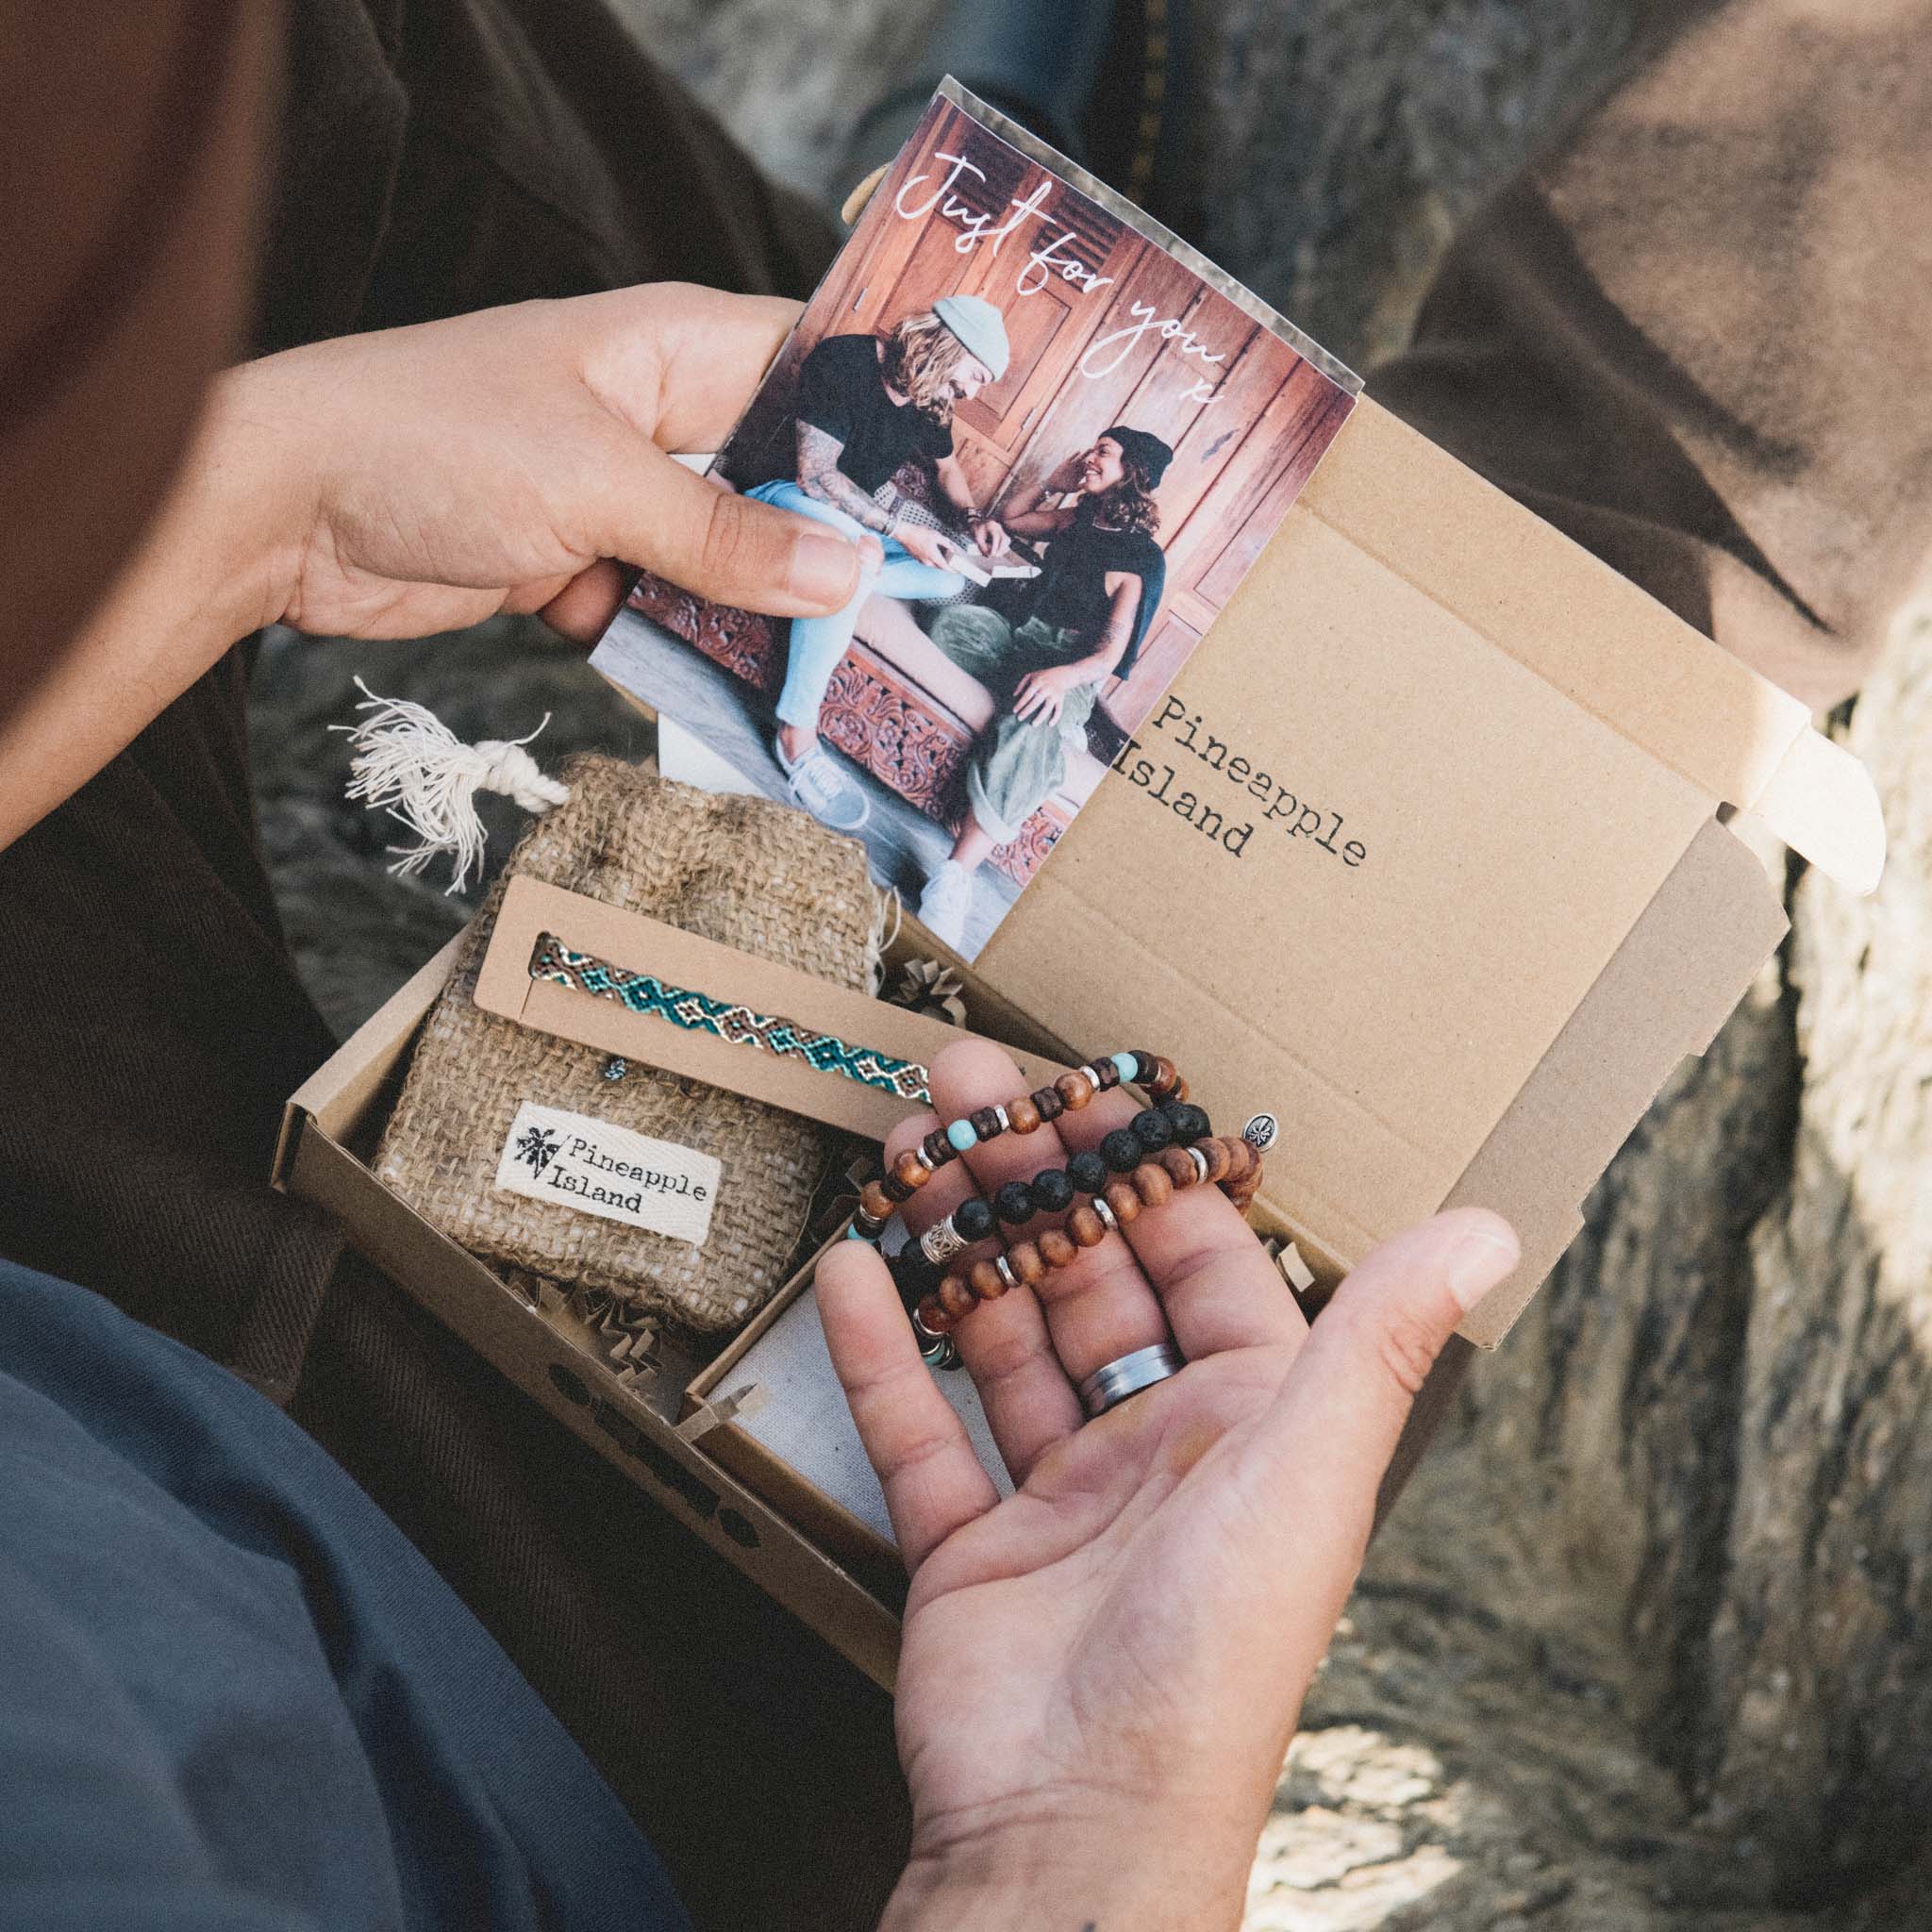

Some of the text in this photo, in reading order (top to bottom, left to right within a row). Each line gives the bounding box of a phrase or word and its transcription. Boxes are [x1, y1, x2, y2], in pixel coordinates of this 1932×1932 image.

[896, 152, 1225, 377] Just for you
[1112, 740, 1254, 858] Island
[1152, 695, 1366, 867] Pineapple
[547, 1165, 641, 1213] Island
[569, 1138, 707, 1201] Pineapple
